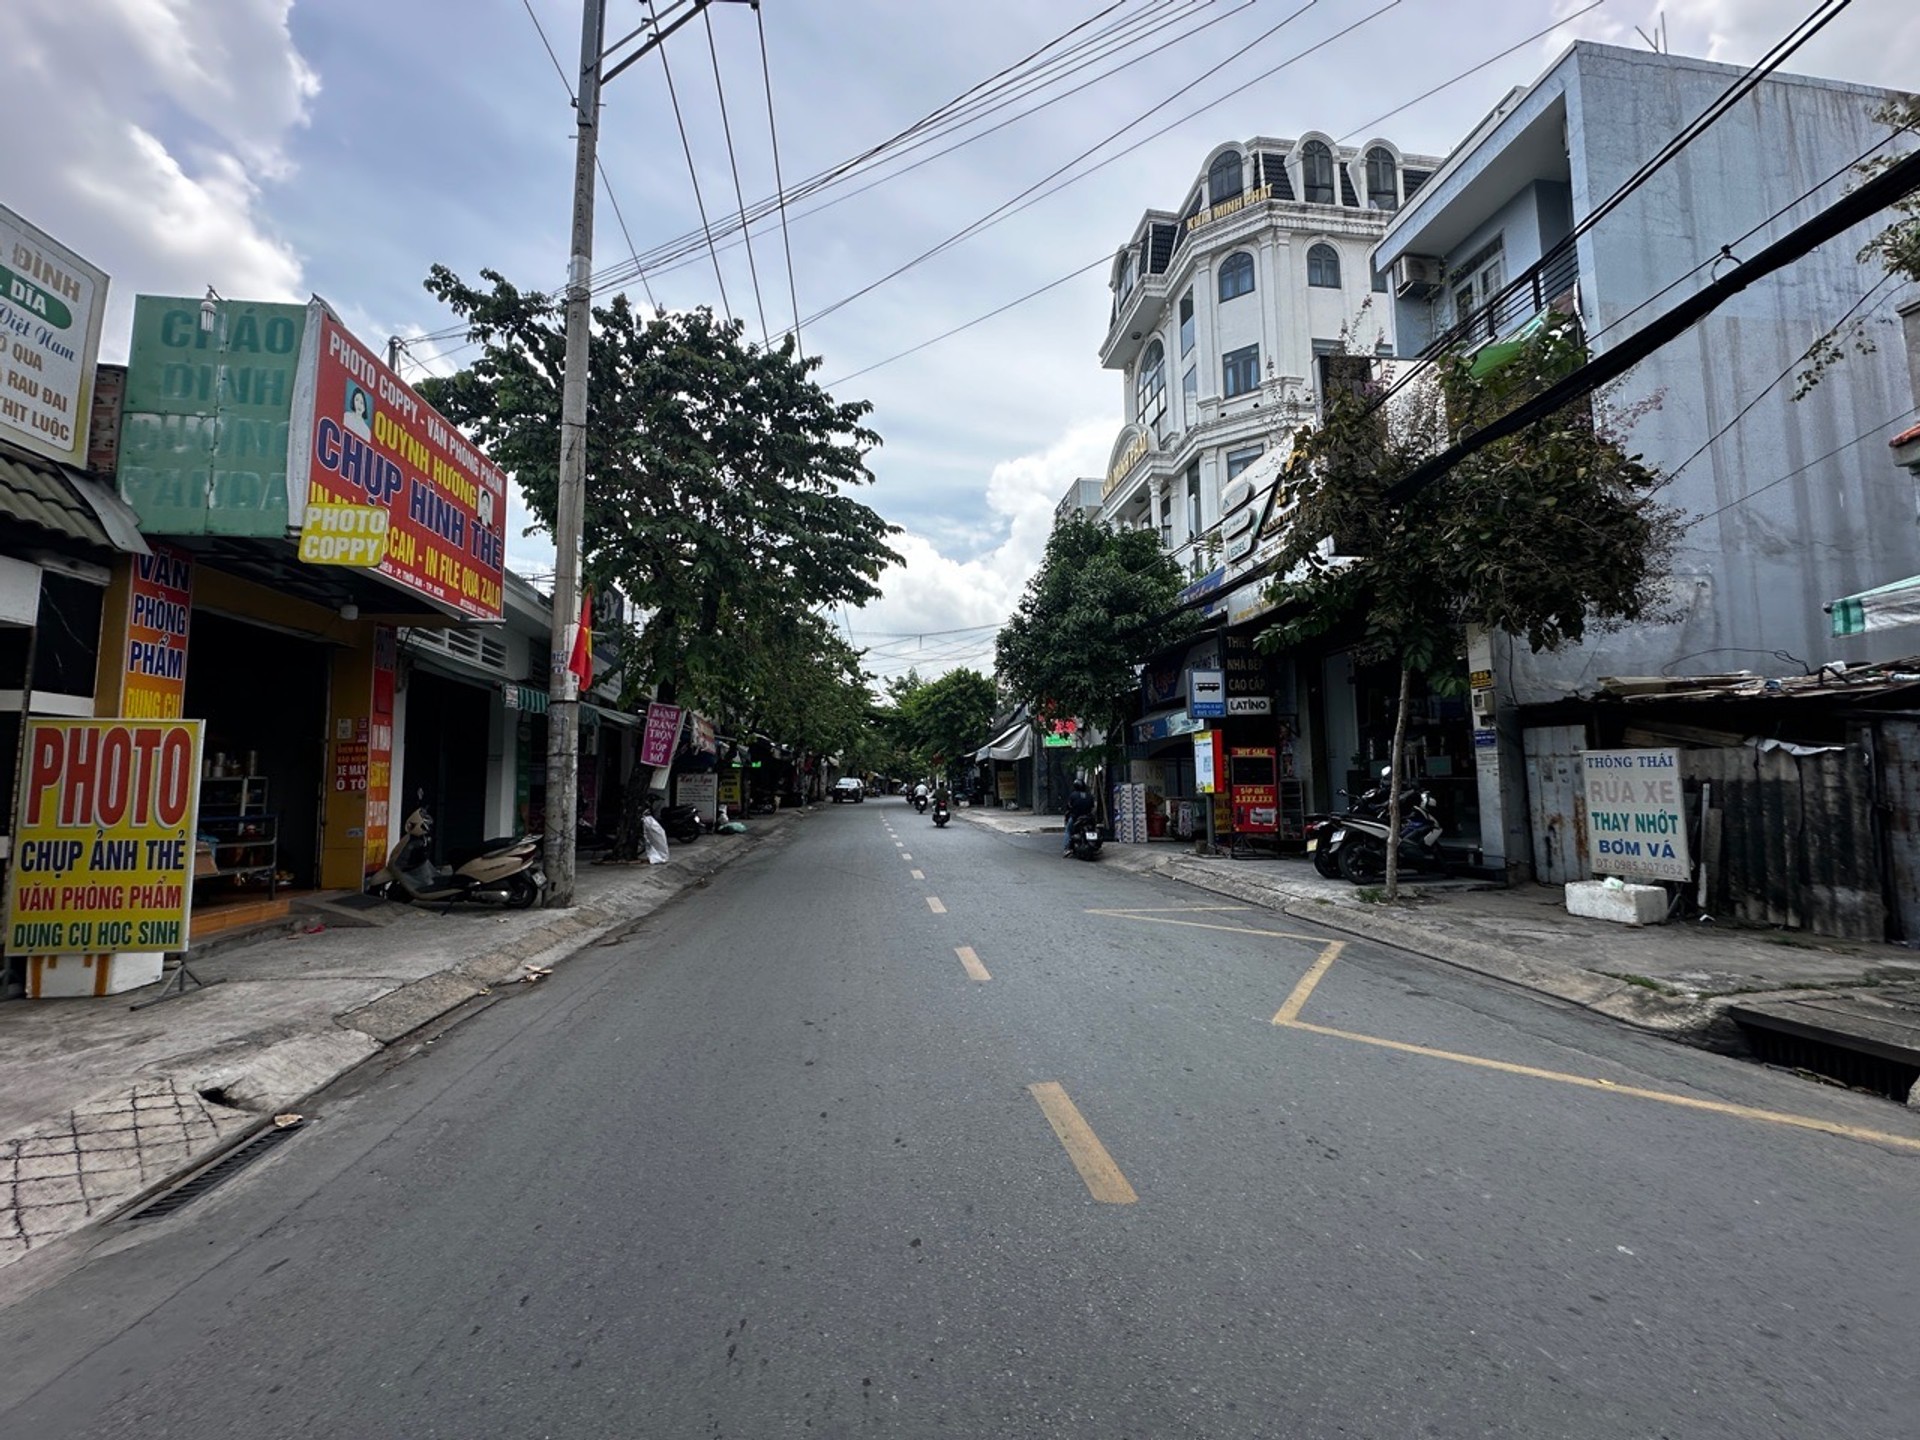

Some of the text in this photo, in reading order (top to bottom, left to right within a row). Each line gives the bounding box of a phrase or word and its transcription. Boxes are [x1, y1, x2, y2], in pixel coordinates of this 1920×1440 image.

[12, 242, 80, 303] ĐÌNH
[12, 342, 43, 372] QUA
[34, 325, 76, 363] Nam
[7, 368, 39, 399] RAU
[329, 330, 376, 390] PHOTO
[379, 373, 419, 426] COPPY
[426, 412, 448, 450] VĂN
[373, 410, 477, 509] QUỲNH HƯƠNG
[316, 416, 404, 507] CHỤP
[409, 476, 466, 550] HÌNH
[305, 506, 387, 535] PHOTO
[304, 534, 380, 562] COPPY
[138, 549, 191, 594] VĂN
[425, 545, 439, 579] IN
[439, 552, 461, 590] FILE
[461, 566, 480, 600] QUA
[480, 577, 501, 611] ZALO
[132, 590, 187, 636] PHÒNG
[127, 634, 184, 681] PHẨM
[1228, 677, 1247, 692] CAO
[24, 726, 192, 828] PHOTO
[1586, 754, 1633, 769] THÔNG
[1590, 772, 1675, 804] RỬA XE
[1591, 808, 1678, 835] THAY NHỚT
[20, 829, 186, 879] CHỤP ẢNH THẺ
[1598, 839, 1676, 859] BƠM VÁ
[18, 876, 183, 912] VĂN PHÒNG PHẨM
[14, 920, 180, 953] DỤNG CỤ HỌC SINH
